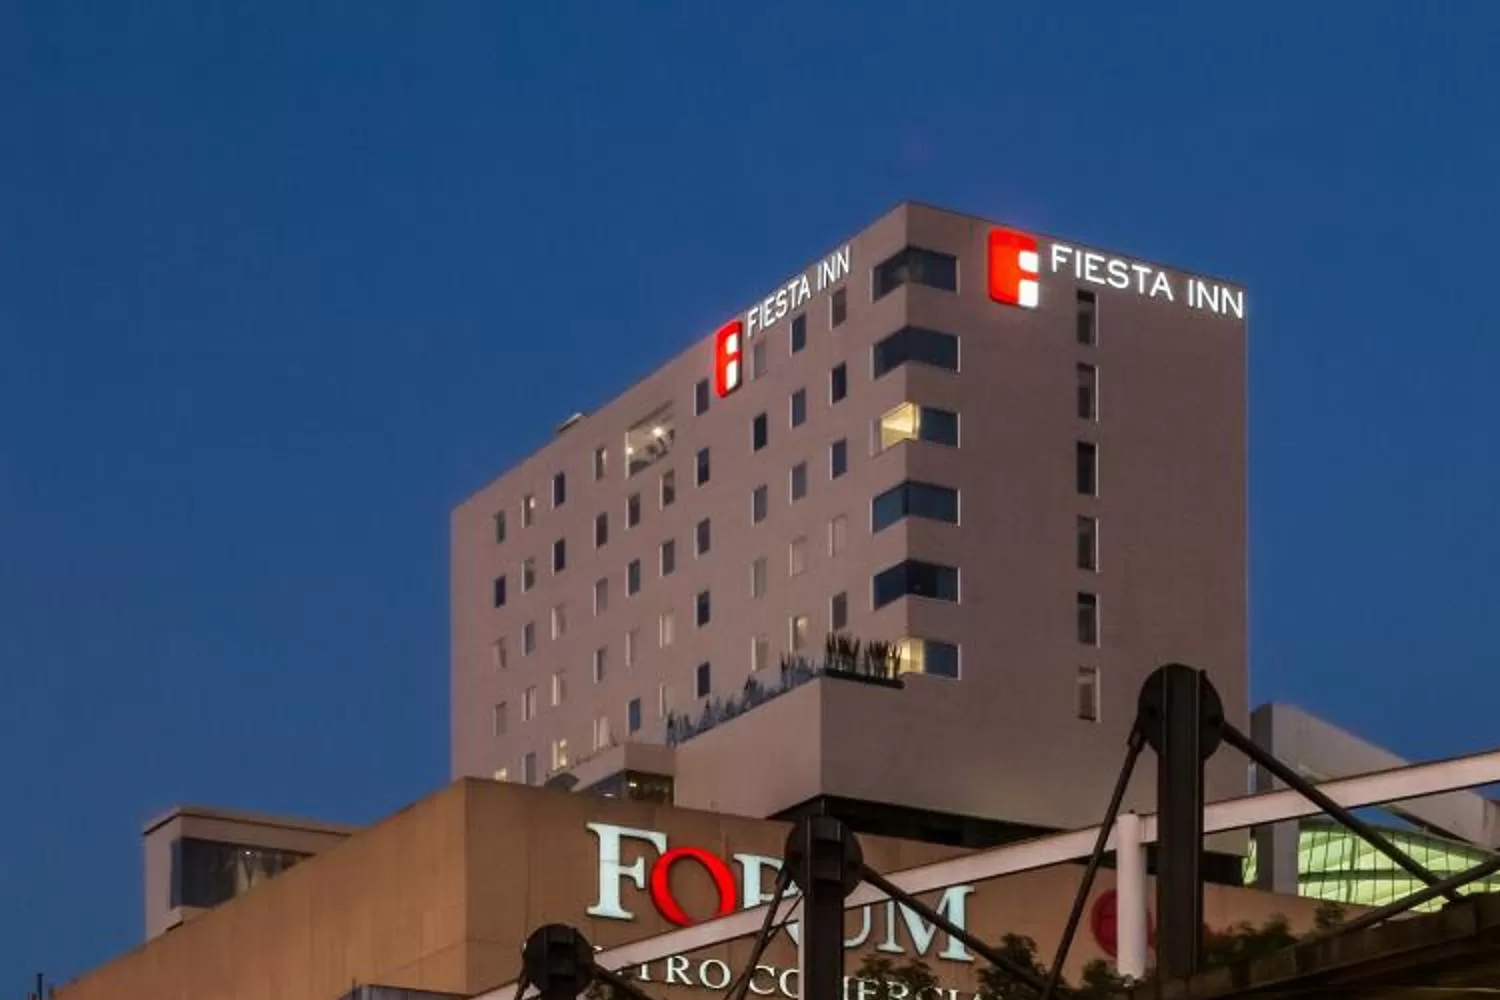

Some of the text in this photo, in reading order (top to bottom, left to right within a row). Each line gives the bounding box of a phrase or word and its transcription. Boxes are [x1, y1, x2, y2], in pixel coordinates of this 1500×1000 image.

[747, 244, 850, 338] FIESTA INN
[1051, 244, 1244, 320] FIESTA INN
